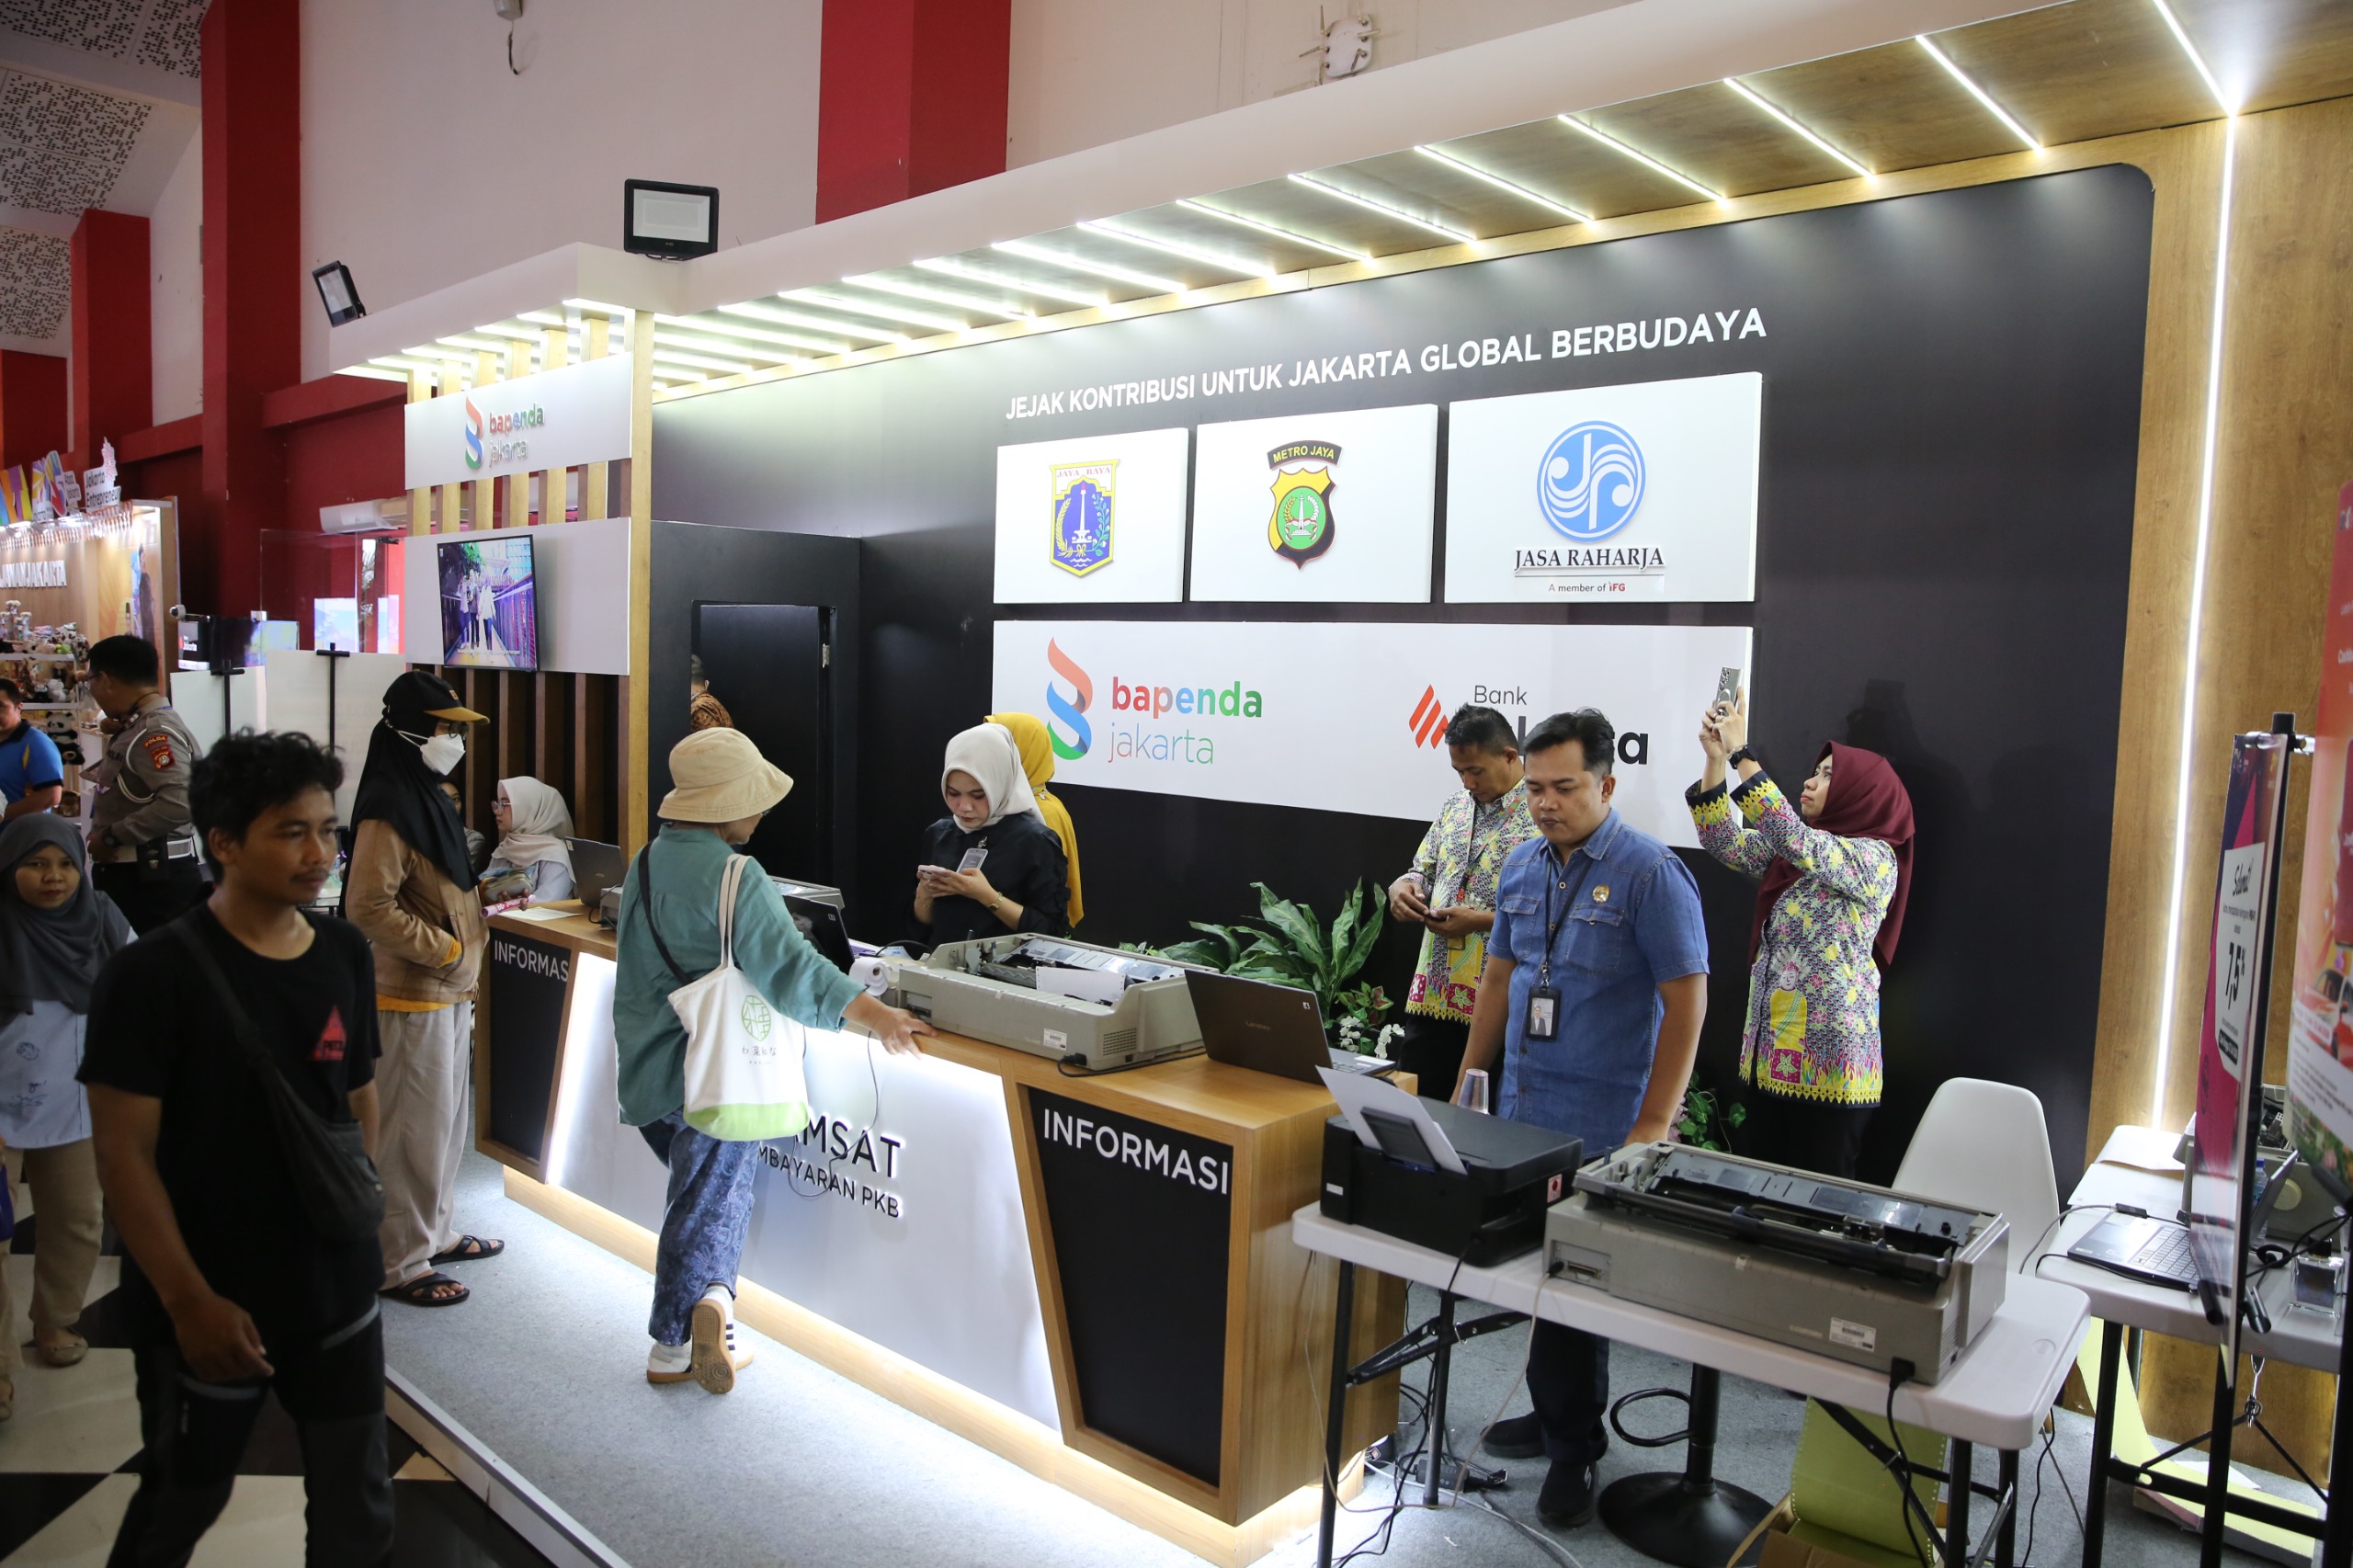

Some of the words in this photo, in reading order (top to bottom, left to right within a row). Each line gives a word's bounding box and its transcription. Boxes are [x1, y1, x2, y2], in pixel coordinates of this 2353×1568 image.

[1006, 391, 1064, 420] JEJAK
[1069, 374, 1196, 413] KONTRIBUSI
[1201, 363, 1283, 397] UNTUK
[1288, 347, 1413, 387] JAKARTA
[1420, 333, 1542, 373] GLOBAL
[1552, 307, 1768, 359] BERBUDAYA
[489, 403, 545, 436] bapenda
[488, 438, 528, 468] jakarta
[1273, 445, 1309, 463] METRO
[1310, 445, 1335, 460] JAYA
[1056, 469, 1080, 478] JAYA
[1086, 466, 1111, 475] RAYA
[1514, 550, 1562, 572] JASA
[1567, 547, 1665, 571] RAHARJA
[1548, 584, 1556, 592] A
[1558, 583, 1595, 593] member
[1597, 581, 1607, 592] of
[1111, 676, 1263, 720] bapenda
[1473, 685, 1528, 706] Bank
[1108, 722, 1214, 765] jakarta
[796, 1115, 901, 1178] MSAT
[1044, 1108, 1229, 1195] INFORMASI
[862, 1186, 900, 1219] PKB
